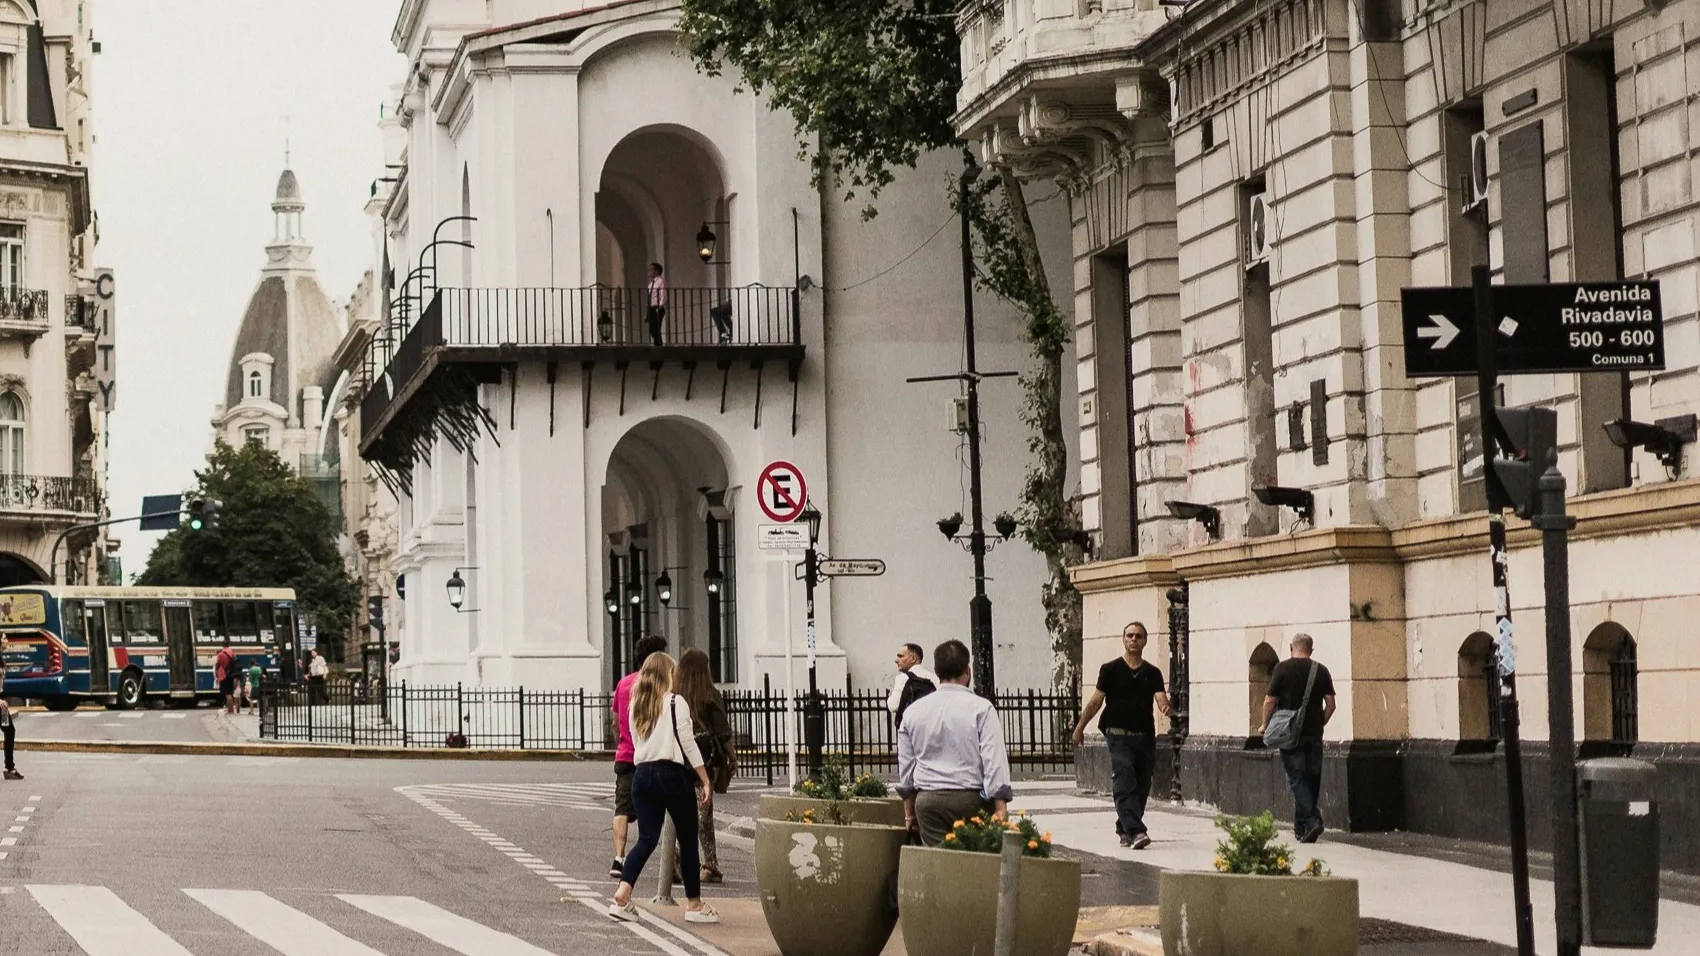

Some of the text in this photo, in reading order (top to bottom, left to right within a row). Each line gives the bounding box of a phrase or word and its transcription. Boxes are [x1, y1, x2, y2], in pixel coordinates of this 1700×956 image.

[1574, 284, 1651, 303] Avenida
[1561, 305, 1653, 324] Rivadavia
[1569, 331, 1603, 347] 500
[1620, 329, 1655, 346] 600
[1592, 352, 1654, 365] Comuna 1
